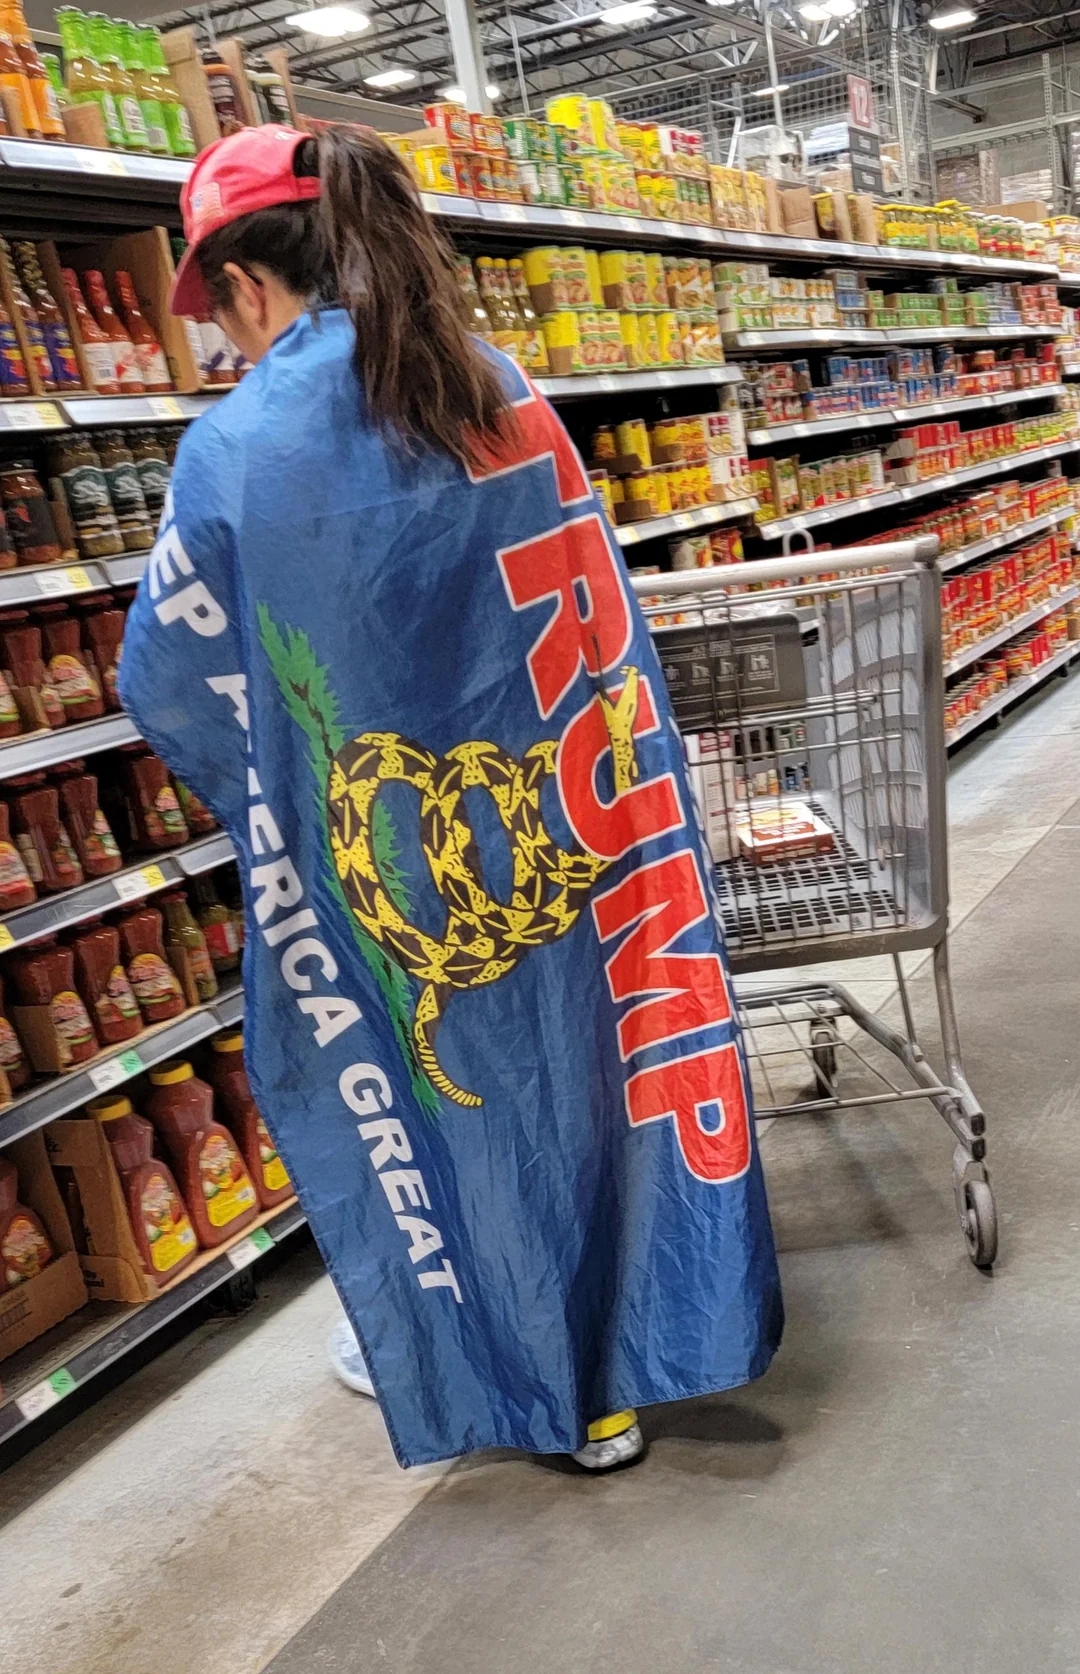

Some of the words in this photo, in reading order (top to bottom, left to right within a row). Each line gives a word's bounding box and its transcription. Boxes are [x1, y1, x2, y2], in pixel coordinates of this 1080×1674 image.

[149, 484, 228, 638] EP
[337, 1061, 465, 1306] GREAT
[464, 355, 752, 1185] TRUMP
